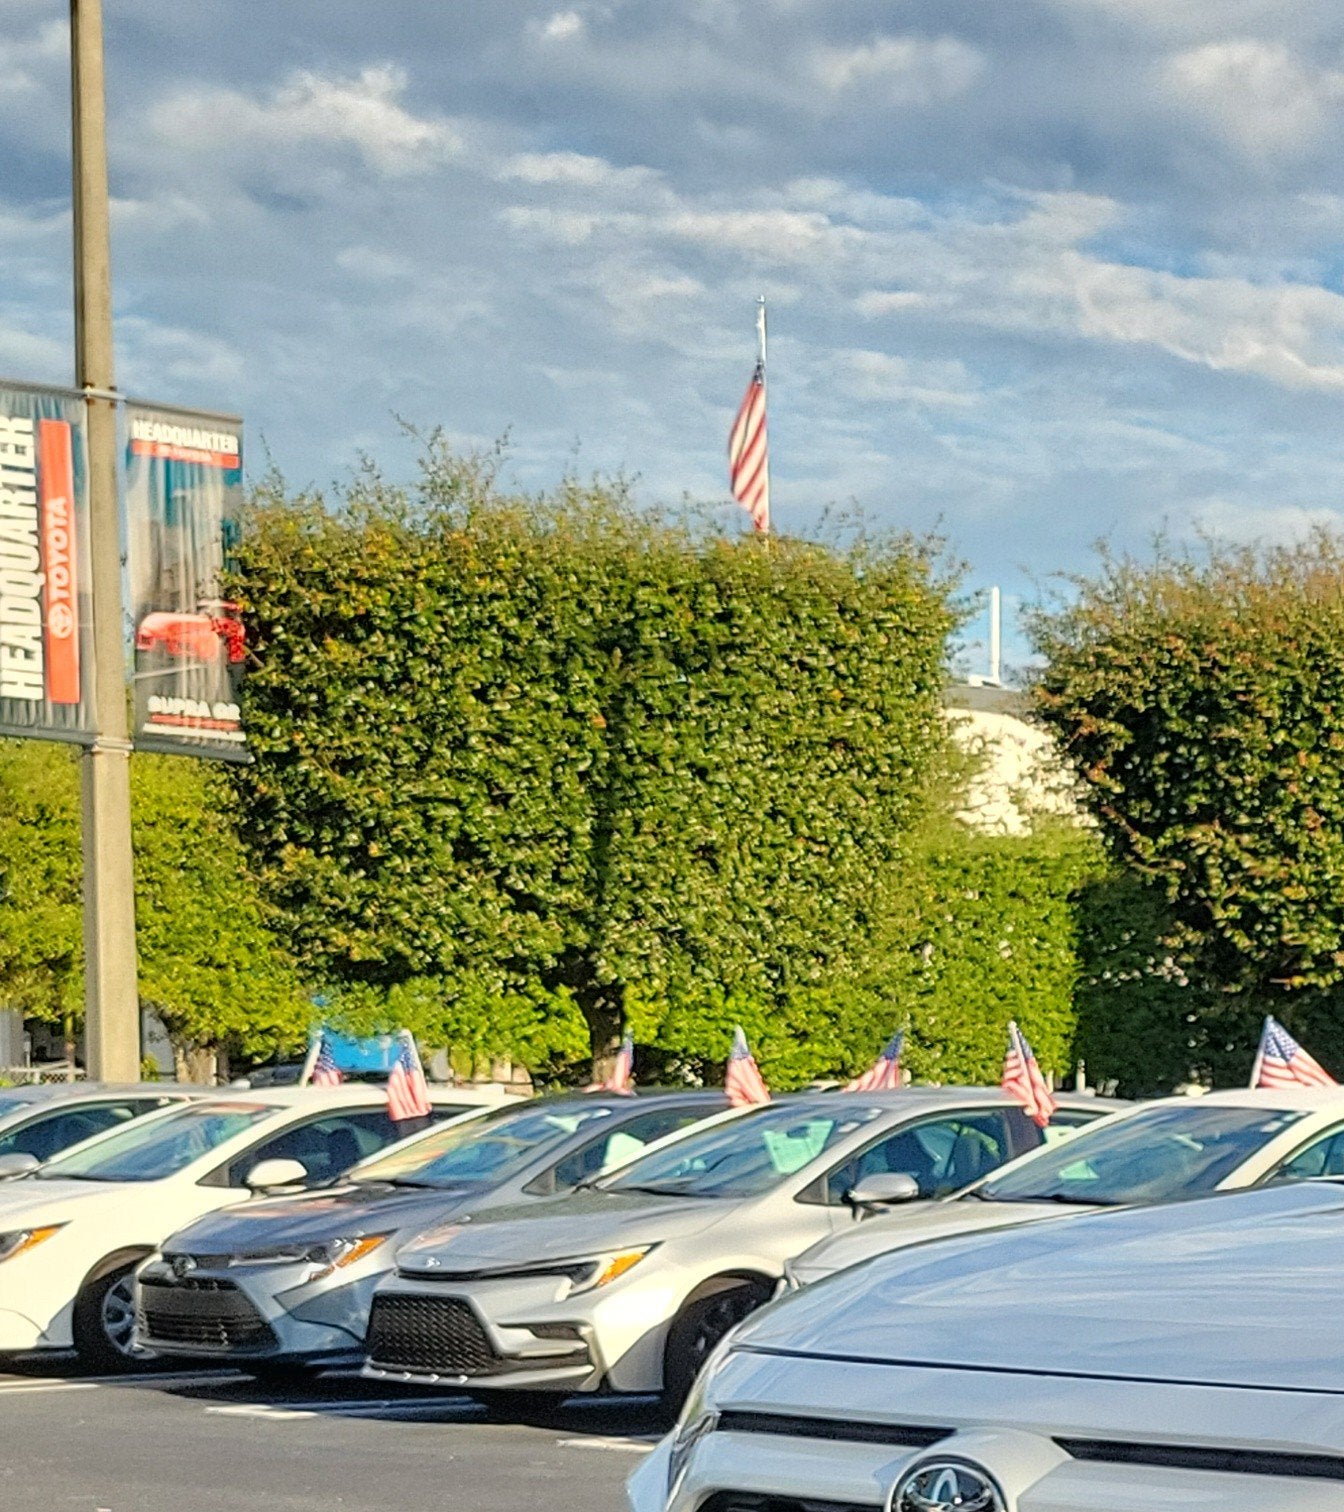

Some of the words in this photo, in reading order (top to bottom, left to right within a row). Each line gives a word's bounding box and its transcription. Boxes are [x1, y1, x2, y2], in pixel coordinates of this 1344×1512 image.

[133, 419, 238, 455] HEADQUARTER
[0, 417, 45, 699] HEADQUARTER
[45, 496, 71, 600] TOYOTA
